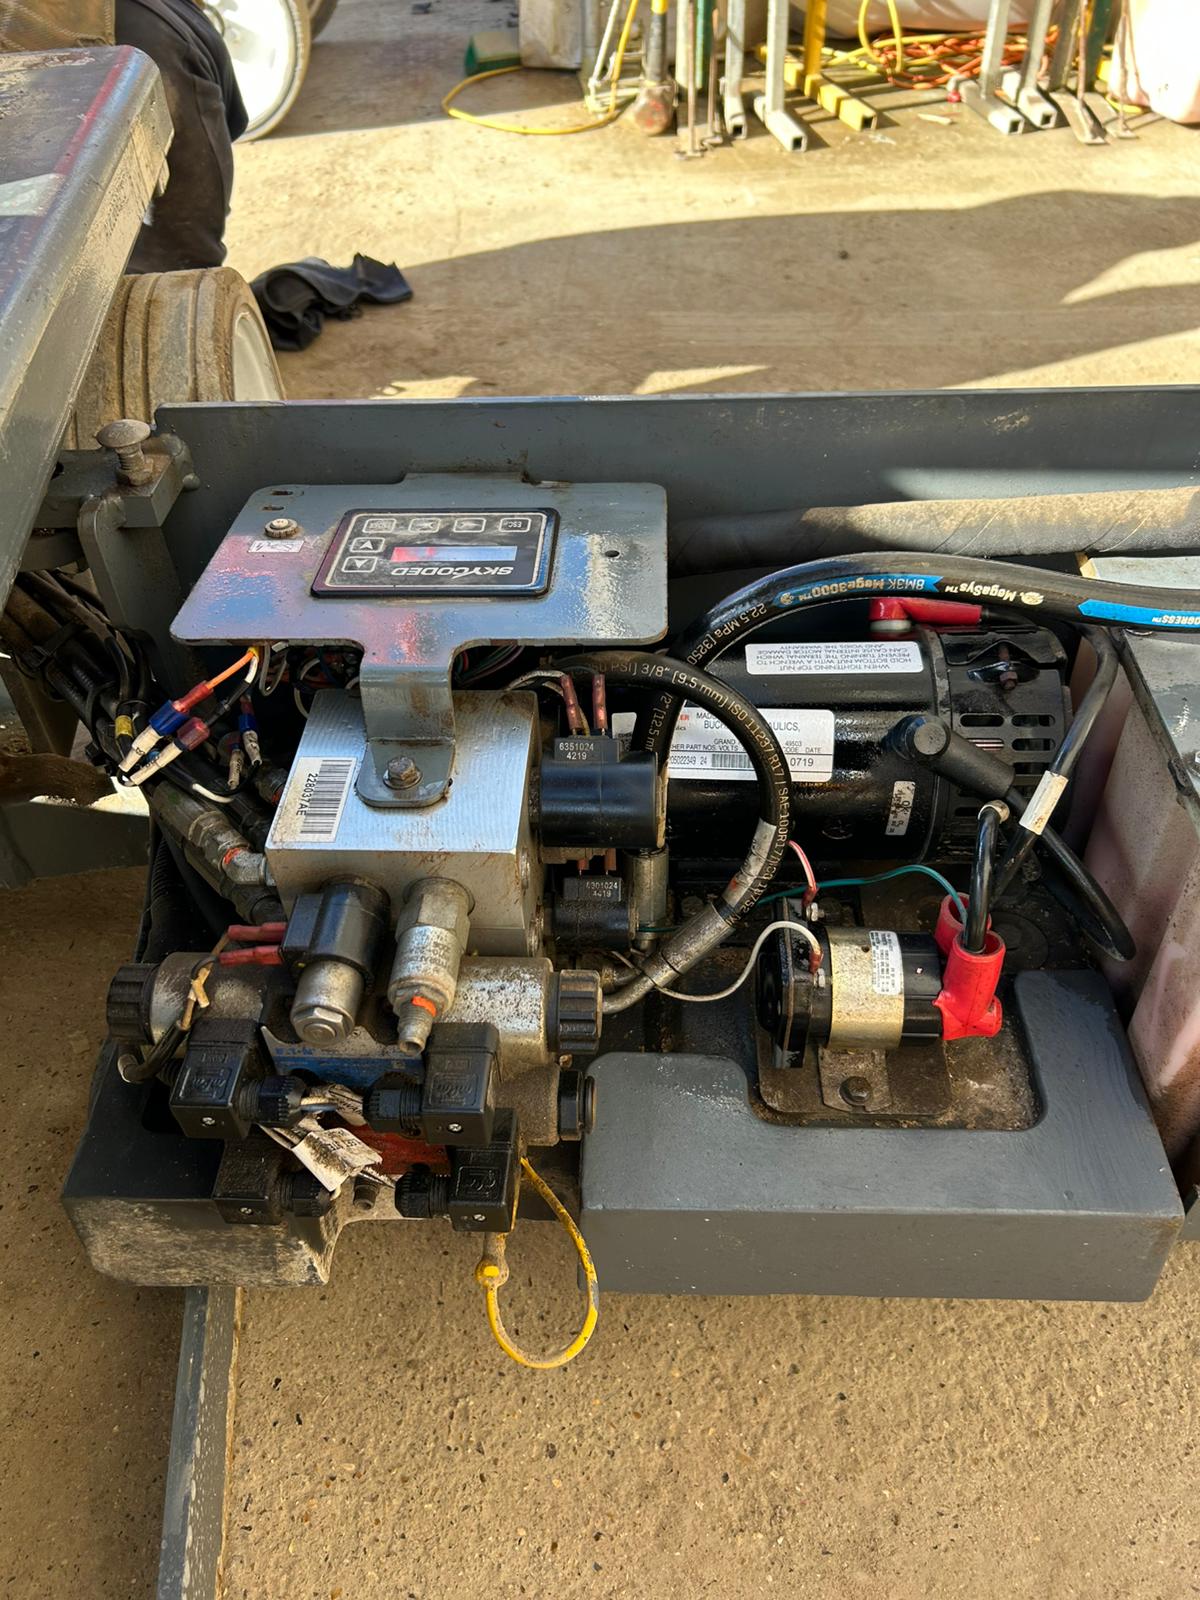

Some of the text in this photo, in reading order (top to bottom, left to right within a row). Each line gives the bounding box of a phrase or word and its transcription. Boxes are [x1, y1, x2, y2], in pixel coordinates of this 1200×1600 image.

[391, 566, 514, 579] SKYCODED
[888, 578, 926, 590] 8M3K
[740, 602, 767, 623] 22.5
[714, 620, 740, 638] MPa
[660, 692, 672, 709] /2"
[728, 699, 746, 720] ISO
[744, 718, 775, 748] 11237
[768, 754, 784, 777] R17
[559, 742, 594, 751] 6351024
[566, 751, 587, 760] 4219
[790, 758, 814, 767] 0719
[296, 772, 318, 816] 228037AE
